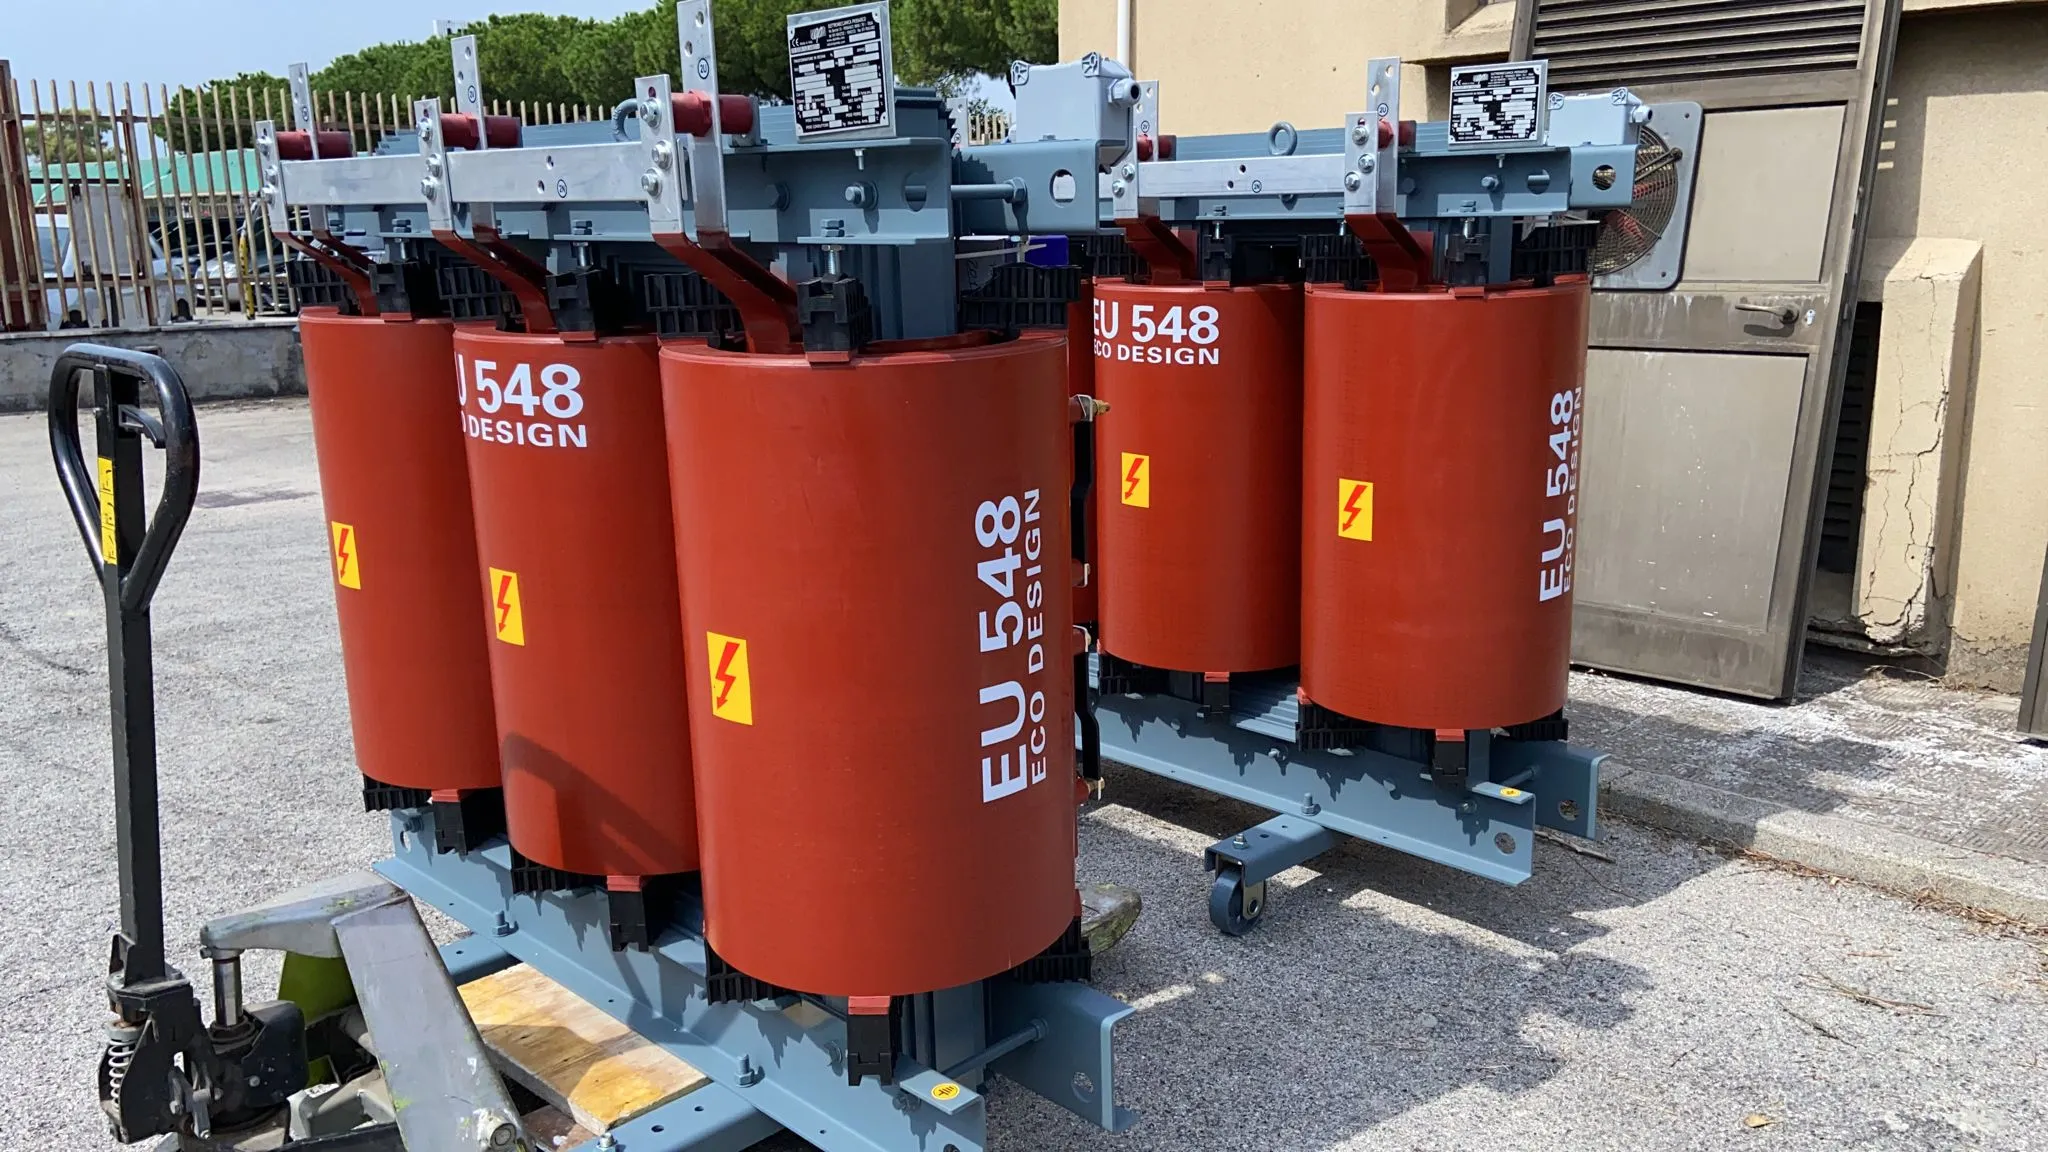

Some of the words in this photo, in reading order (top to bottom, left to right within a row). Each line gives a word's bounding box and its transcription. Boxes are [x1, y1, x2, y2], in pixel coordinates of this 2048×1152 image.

[1094, 298, 1118, 339] EU
[1132, 304, 1219, 344] 548
[1118, 344, 1219, 365] DESIGN
[454, 352, 466, 406] U
[474, 360, 584, 418] 548
[468, 414, 587, 448] DESIGN
[1546, 389, 1574, 497] 548
[1568, 386, 1582, 514] DESIGN
[975, 496, 1023, 652] 548
[1024, 488, 1044, 674] DESIGN
[1539, 518, 1565, 602] EU
[1564, 528, 1574, 593] ECO
[979, 680, 1027, 803] EU
[1030, 690, 1047, 784] ECO
